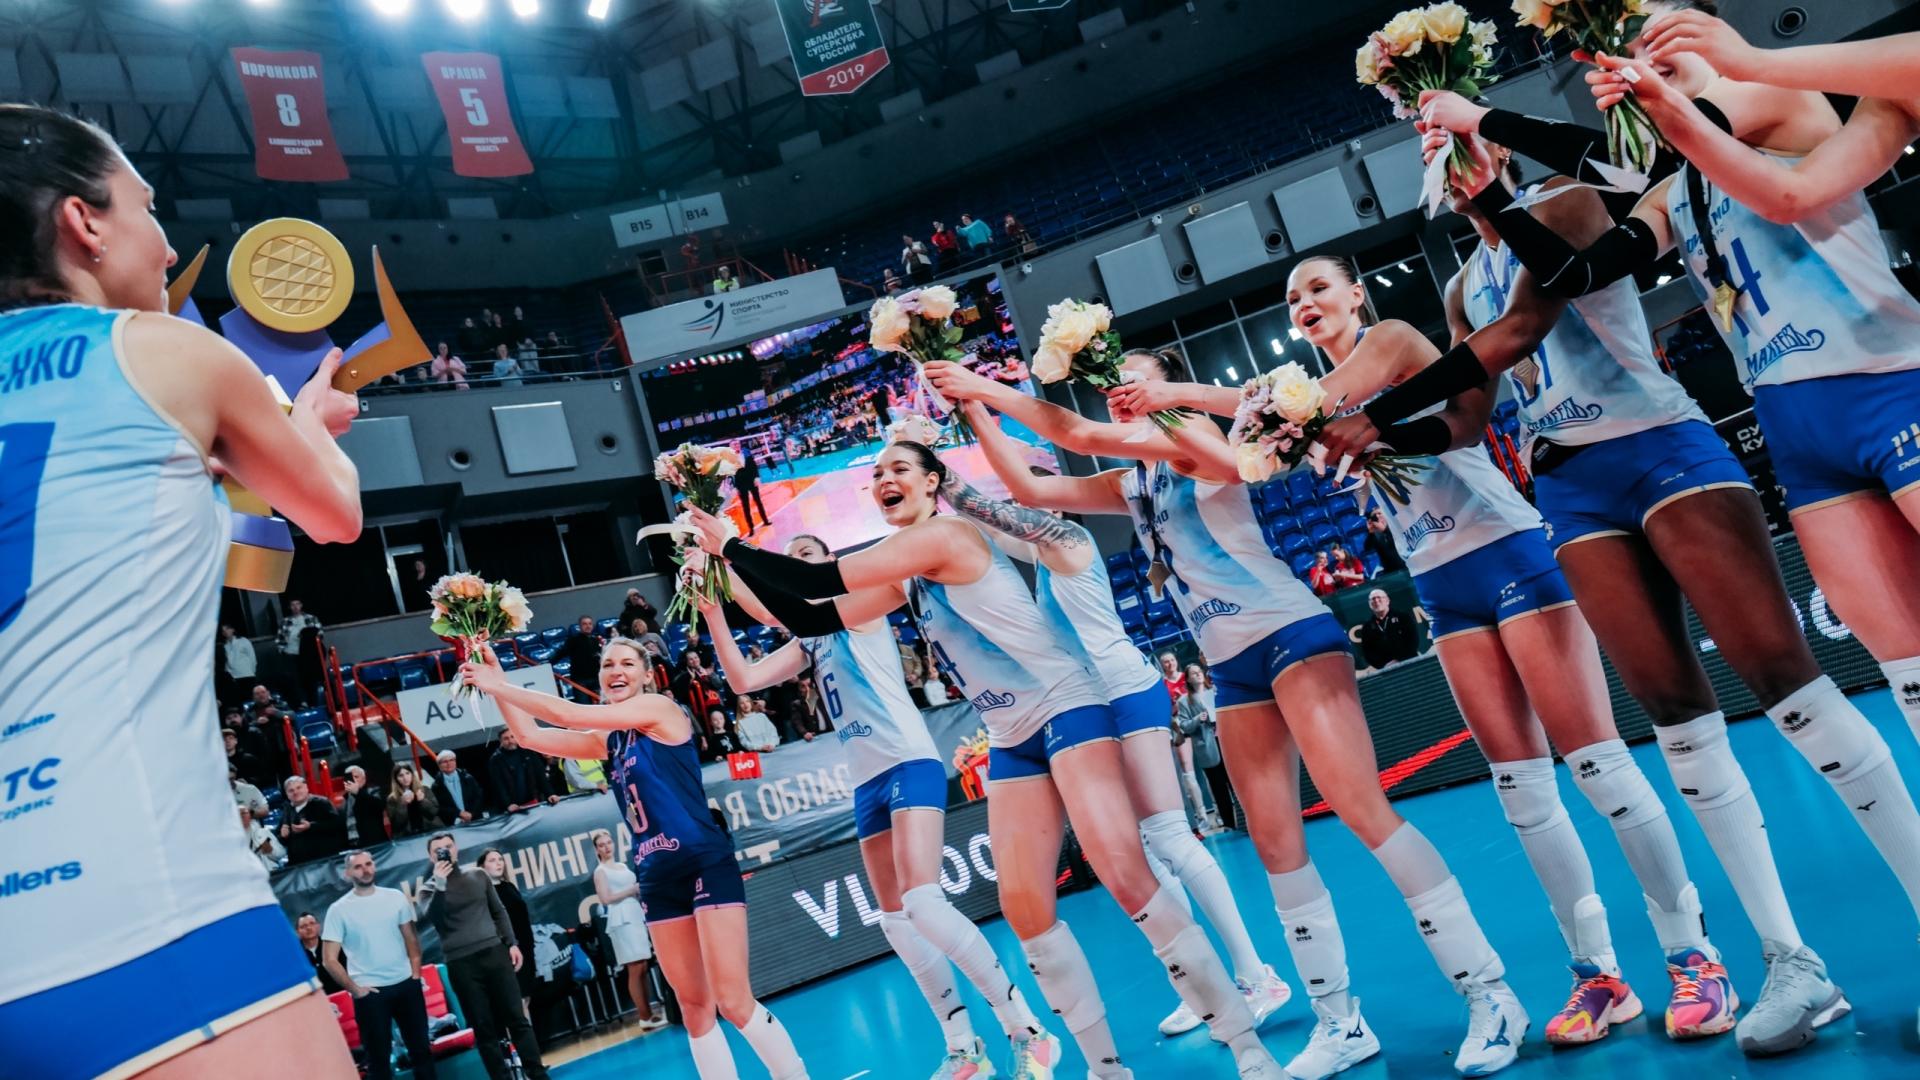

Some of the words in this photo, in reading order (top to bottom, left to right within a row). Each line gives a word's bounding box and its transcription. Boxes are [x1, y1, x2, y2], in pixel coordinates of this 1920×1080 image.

[804, 21, 862, 49] ОБЛАДАТЕЛЬ
[806, 29, 866, 58] СУПЕРКУБКА
[819, 42, 857, 62] РОССИИ
[240, 61, 318, 79] ВОРОНКОВА
[826, 63, 865, 89] 2019
[275, 93, 301, 127] 8
[459, 87, 489, 126] 5
[729, 289, 789, 307] МИНИСТЕРСТВО
[731, 303, 761, 316] СПОРТА
[0, 334, 89, 394] НКО
[823, 672, 843, 720] 6
[0, 758, 61, 802] ТС
